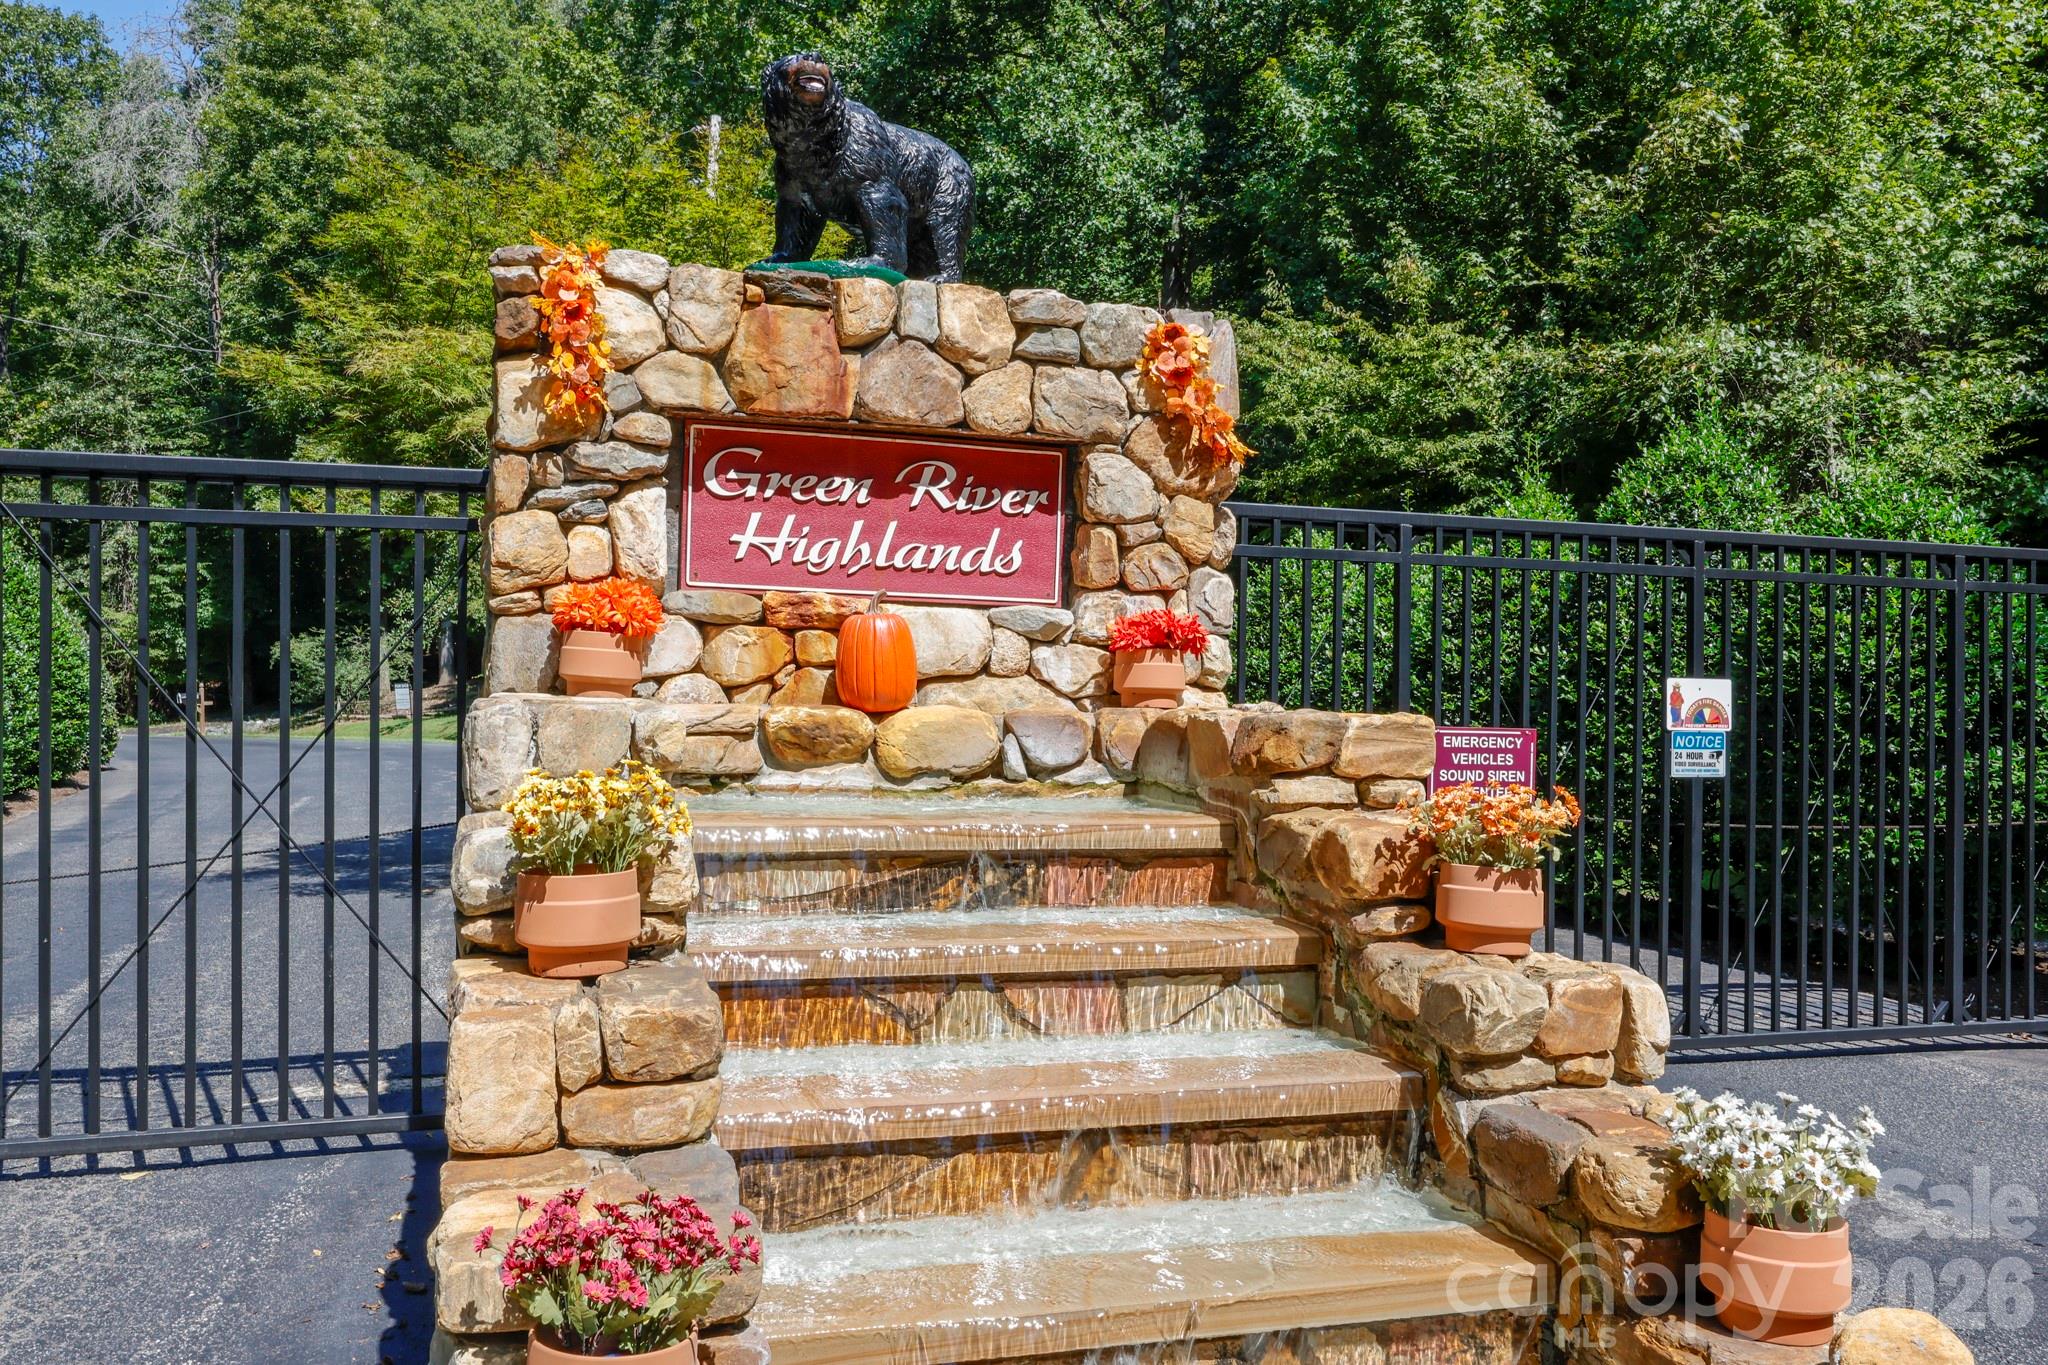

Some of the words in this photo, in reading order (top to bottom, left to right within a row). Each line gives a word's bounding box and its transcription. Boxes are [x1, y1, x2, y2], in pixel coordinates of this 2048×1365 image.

[703, 447, 873, 505] Green
[895, 460, 1049, 516] River
[729, 511, 1024, 577] Highlands
[1443, 735, 1523, 749] EMERGENCY
[1675, 735, 1723, 748] NOTICE
[1452, 753, 1514, 765] VEHICLES
[1674, 751, 1683, 760] 24
[1686, 751, 1704, 760] HOUR
[1439, 769, 1484, 781] SOUND
[1487, 769, 1525, 782] SIREN
